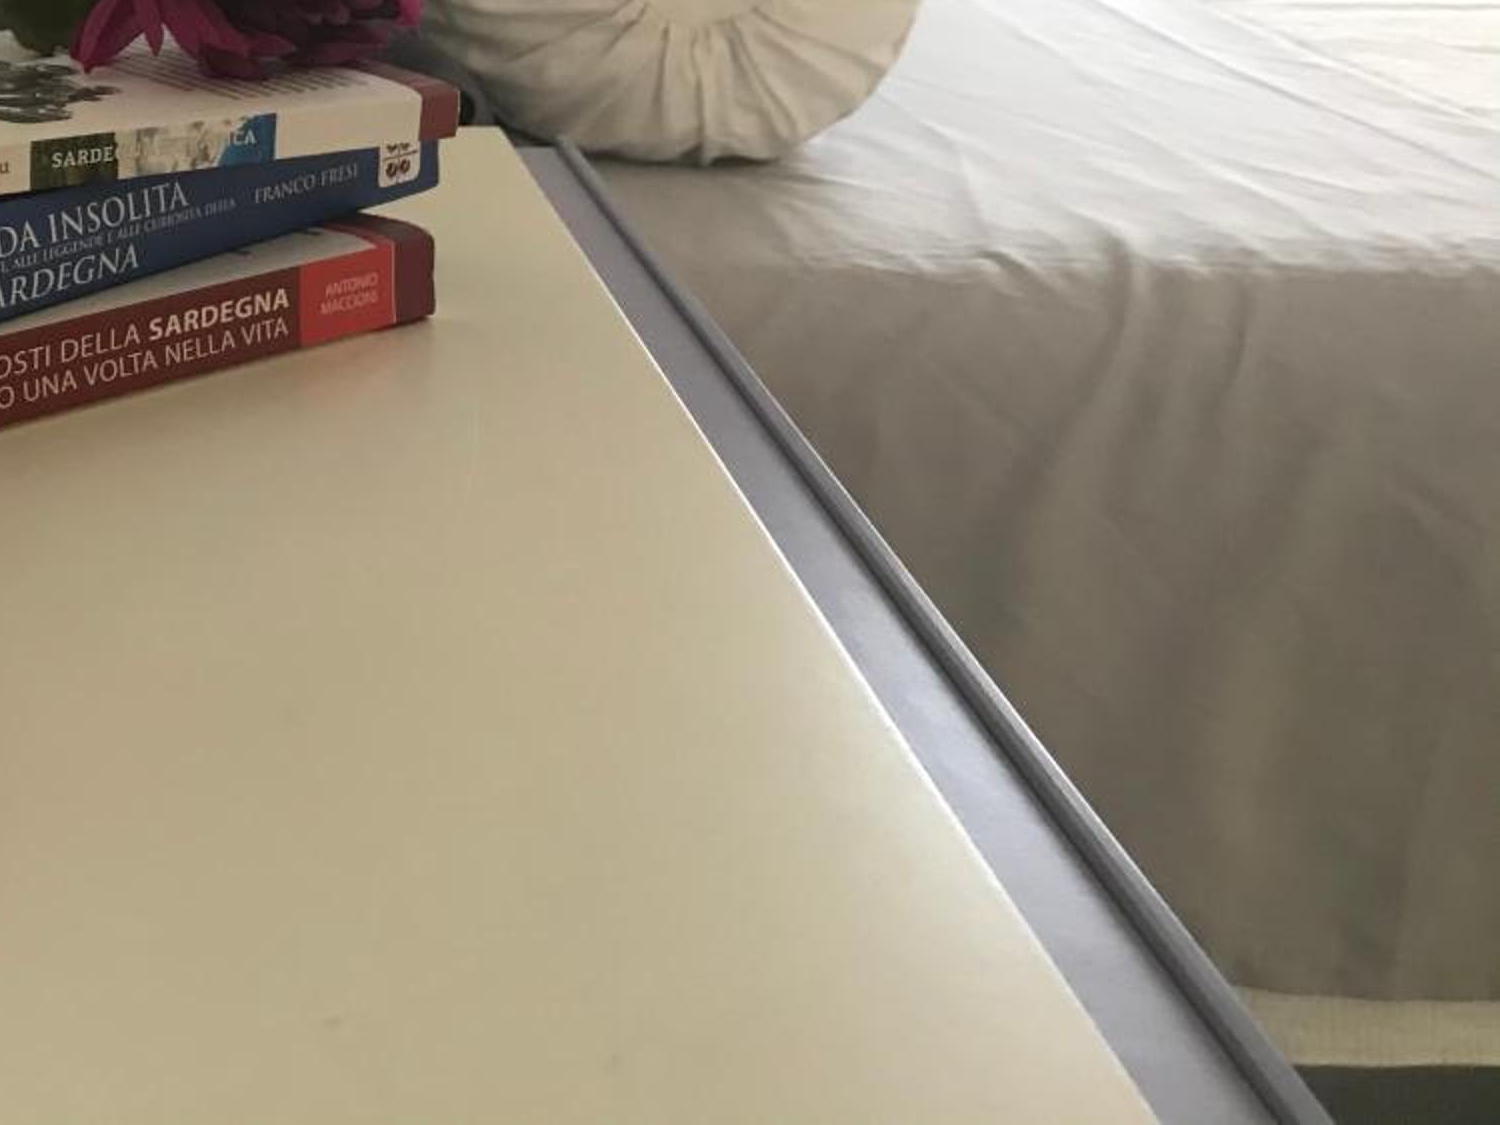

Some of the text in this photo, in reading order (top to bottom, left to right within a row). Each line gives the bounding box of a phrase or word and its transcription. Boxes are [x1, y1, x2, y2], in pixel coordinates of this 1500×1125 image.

[48, 179, 189, 244] INSOLITA
[255, 163, 358, 204] FRANCO FRESI
[325, 272, 379, 298] ANTONIO
[60, 324, 141, 364] DELLA
[150, 287, 290, 342] SARDEGNA
[23, 369, 77, 403] UNA
[83, 349, 158, 386] VOLTA
[165, 330, 236, 366] NELLA
[241, 316, 290, 347] VITA
